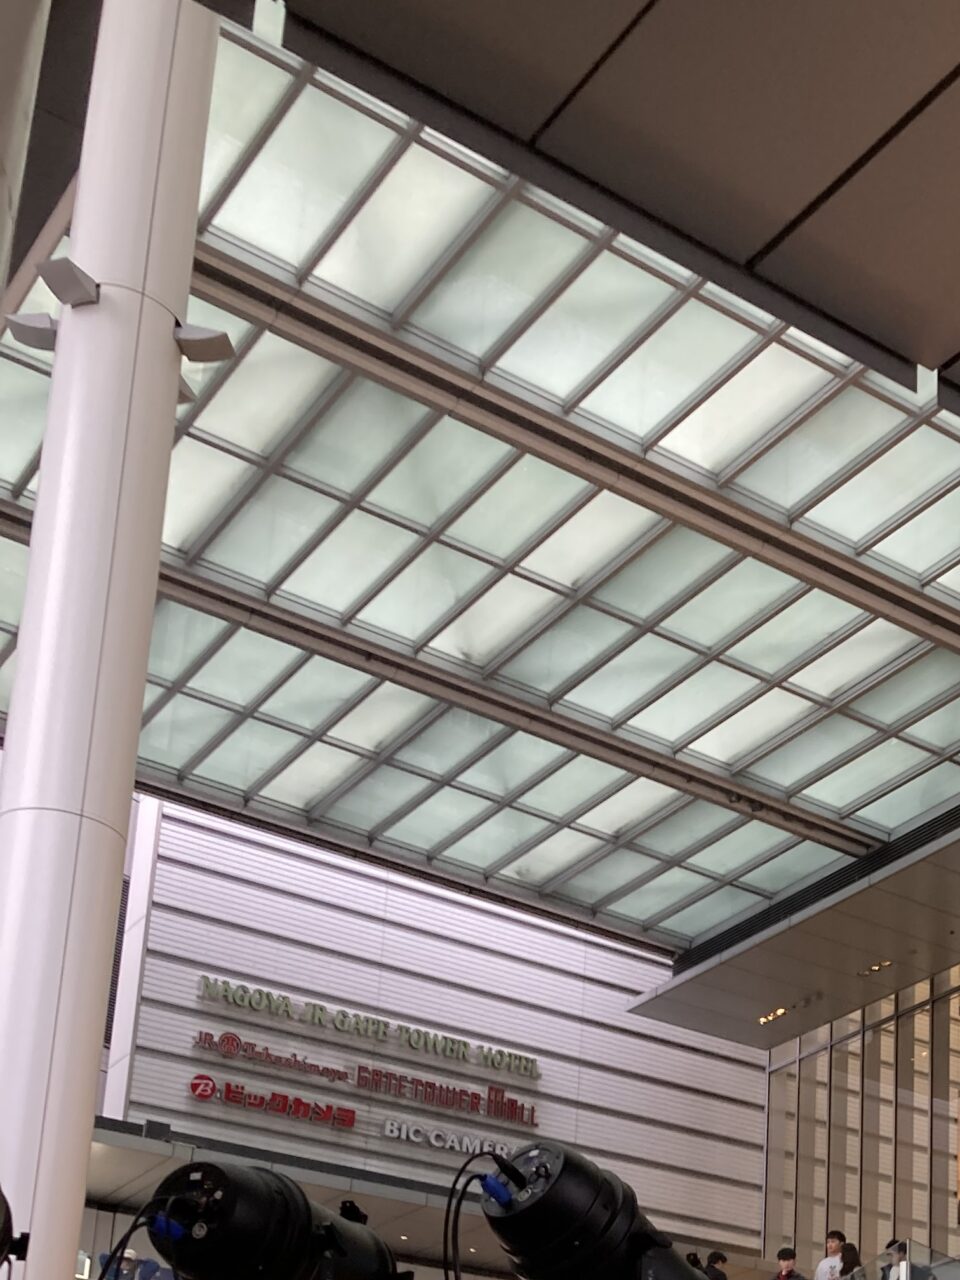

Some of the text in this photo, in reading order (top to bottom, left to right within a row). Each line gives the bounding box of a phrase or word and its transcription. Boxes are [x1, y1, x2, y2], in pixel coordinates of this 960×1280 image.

[199, 975, 541, 1079] NAGOYA JR GATE TOWER HOTEL
[243, 1041, 349, 1082] Takashimaya
[224, 1082, 356, 1128] ビックカメラ
[384, 1120, 423, 1143] BIC
